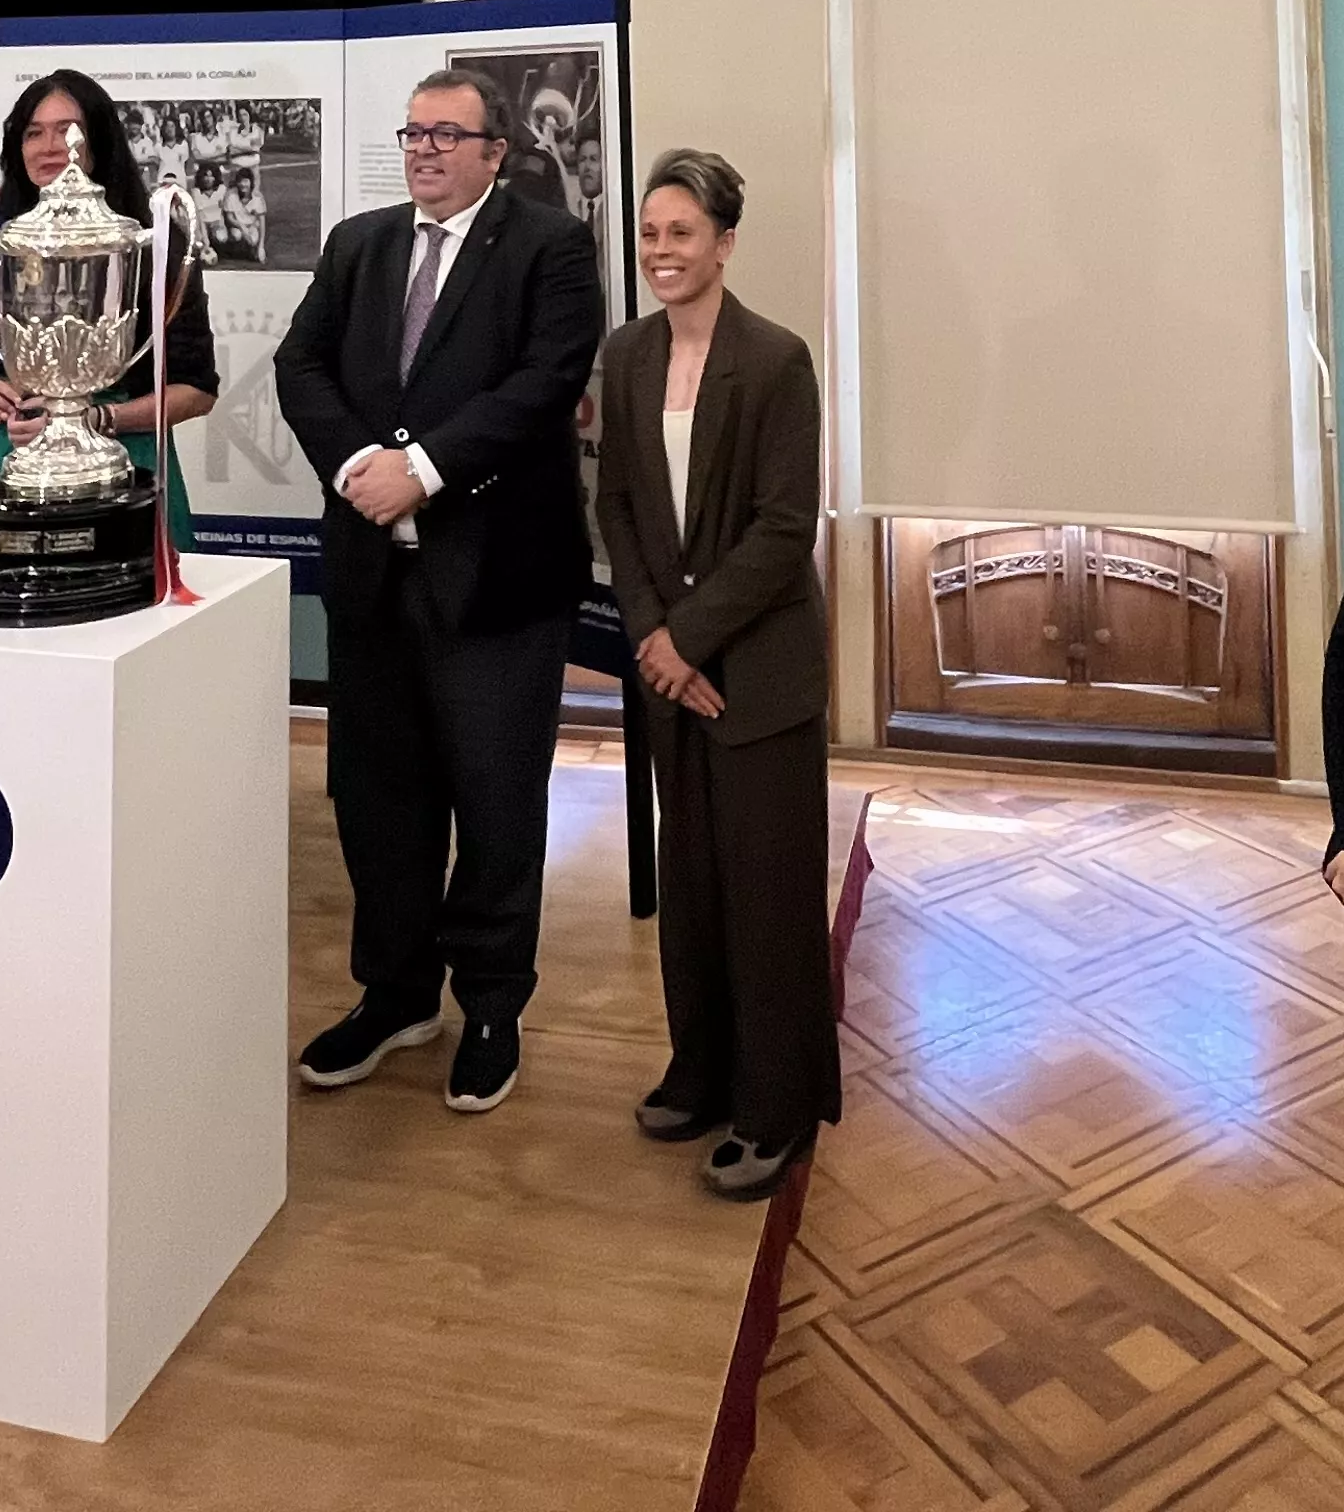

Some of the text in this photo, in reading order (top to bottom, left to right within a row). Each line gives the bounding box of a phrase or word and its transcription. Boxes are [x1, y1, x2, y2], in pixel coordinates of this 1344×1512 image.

[135, 71, 155, 81] DEL
[246, 533, 267, 544] DE
[269, 533, 321, 547] ESPAÑ
